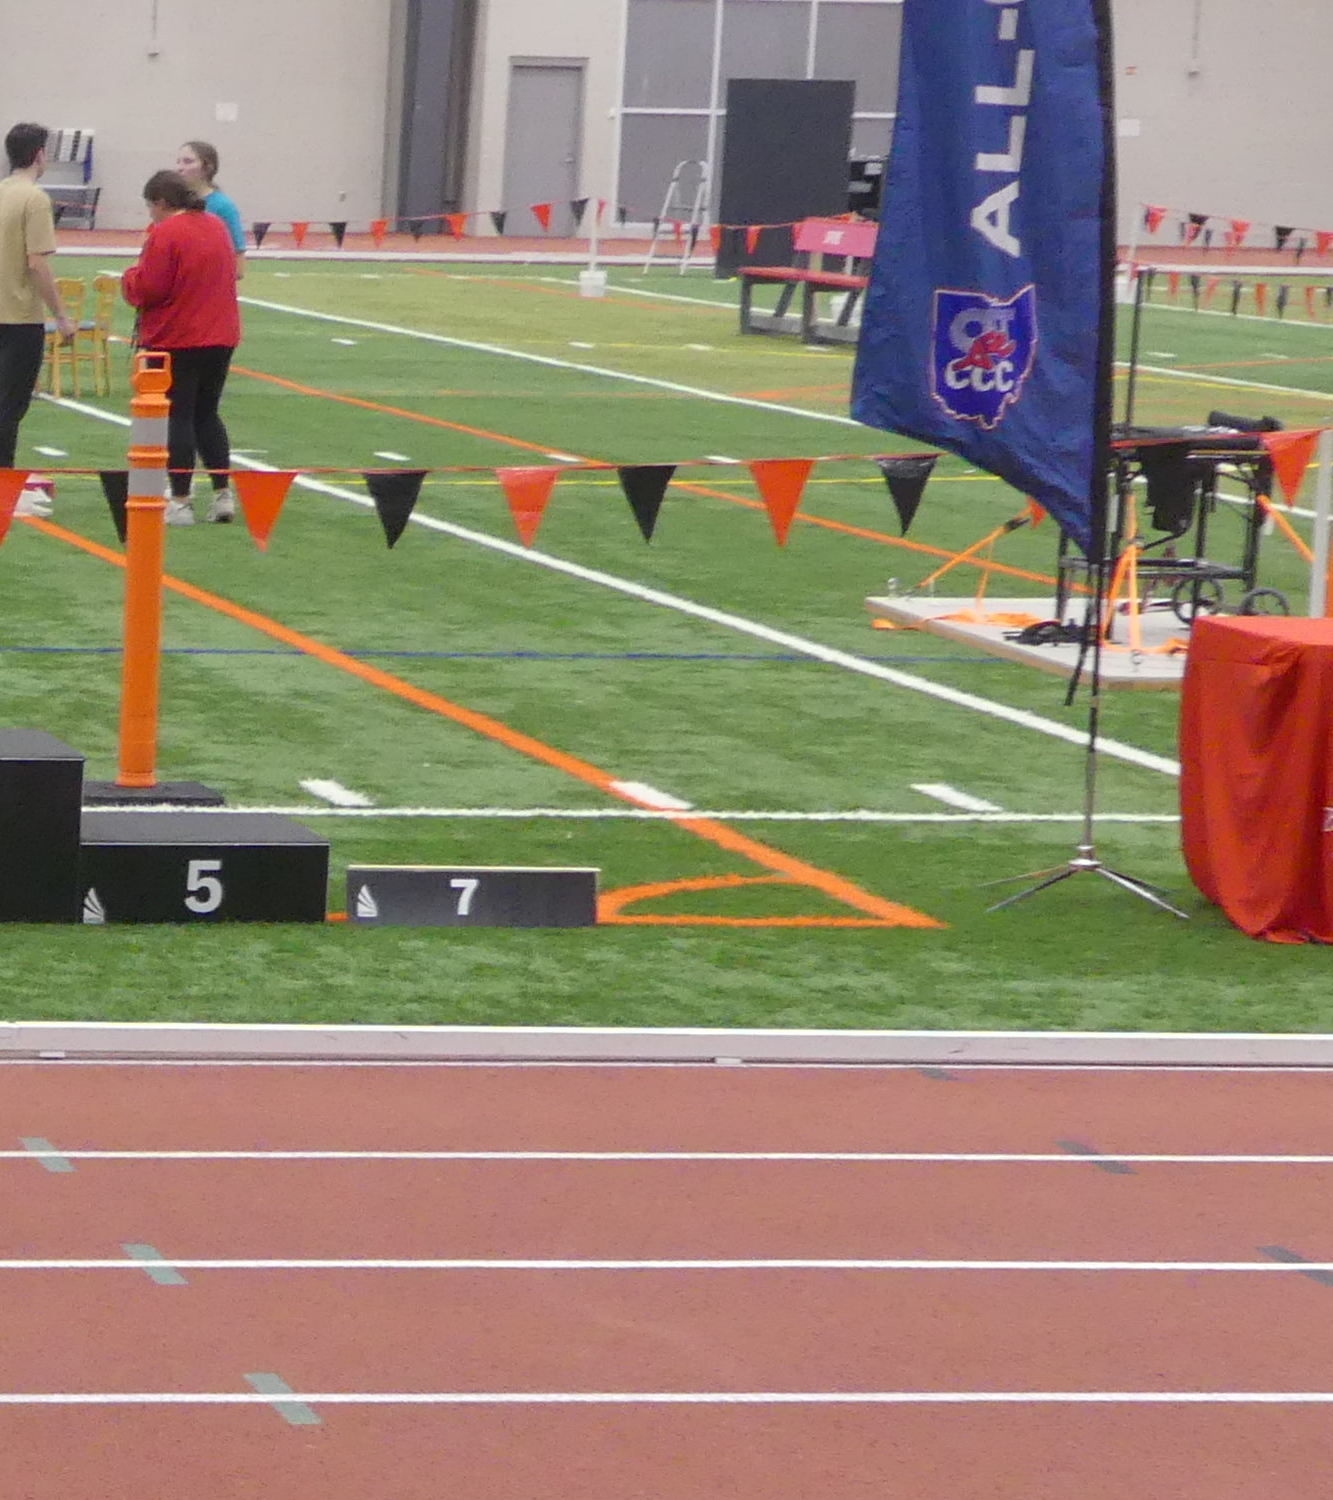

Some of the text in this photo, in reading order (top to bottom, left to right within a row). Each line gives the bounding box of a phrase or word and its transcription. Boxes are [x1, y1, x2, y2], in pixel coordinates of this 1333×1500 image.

[970, 0, 1035, 258] ALL-
[184, 860, 223, 913] 5
[450, 878, 479, 916] 7
